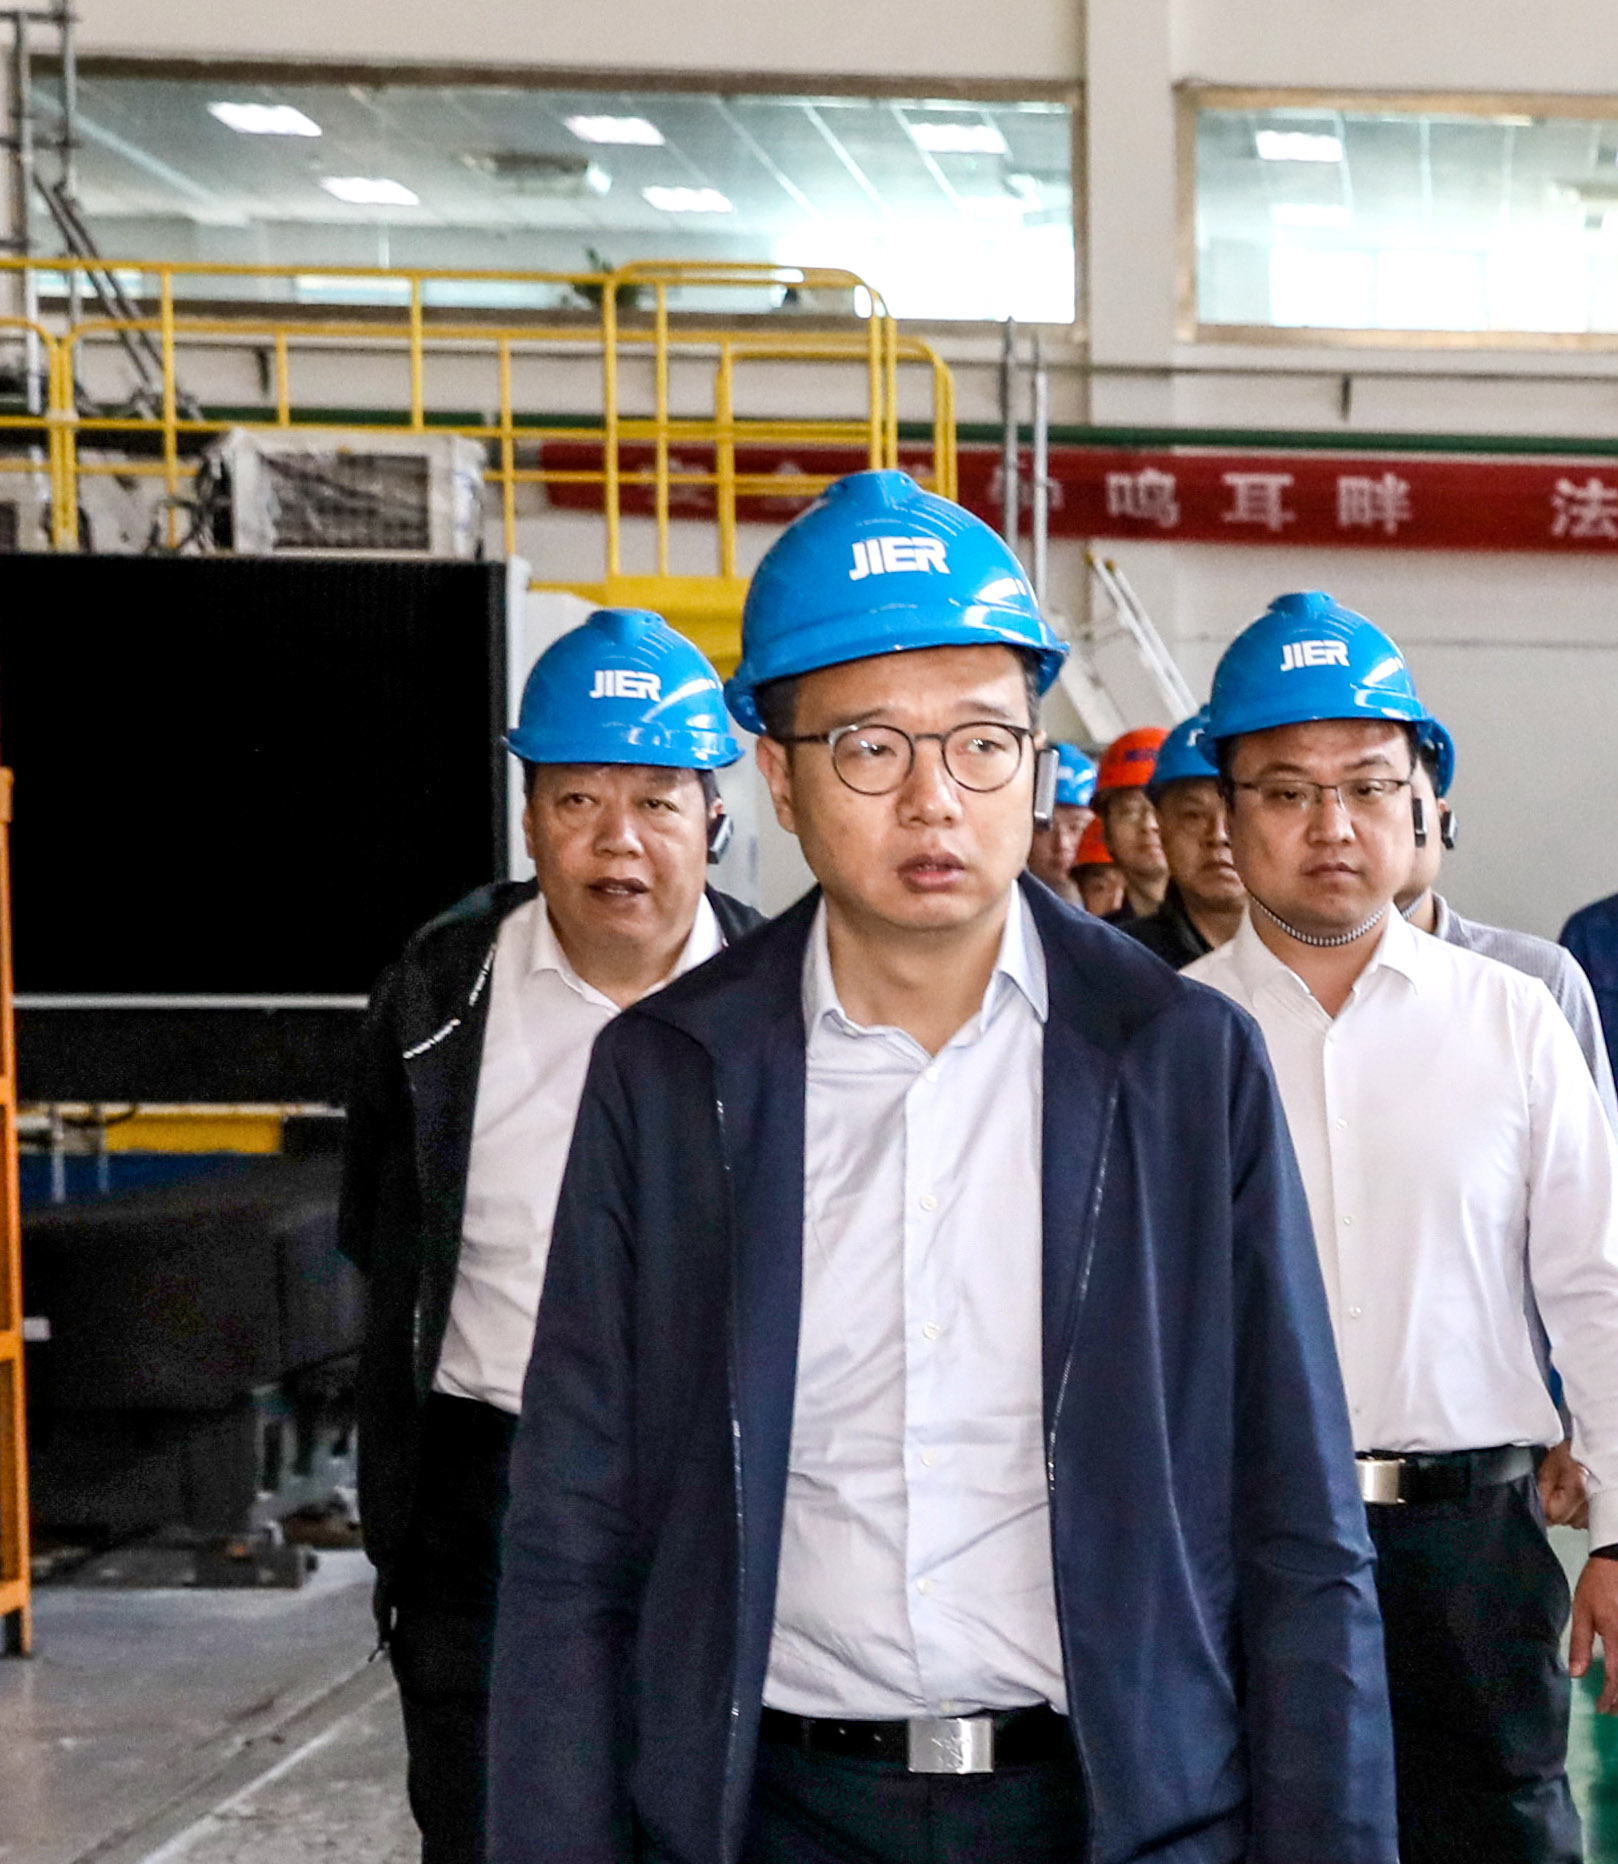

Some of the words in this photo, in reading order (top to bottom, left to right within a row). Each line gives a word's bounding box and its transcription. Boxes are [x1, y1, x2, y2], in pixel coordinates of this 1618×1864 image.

[849, 536, 951, 581] JIER
[1280, 640, 1350, 672] JIER
[589, 670, 661, 703] JIER
